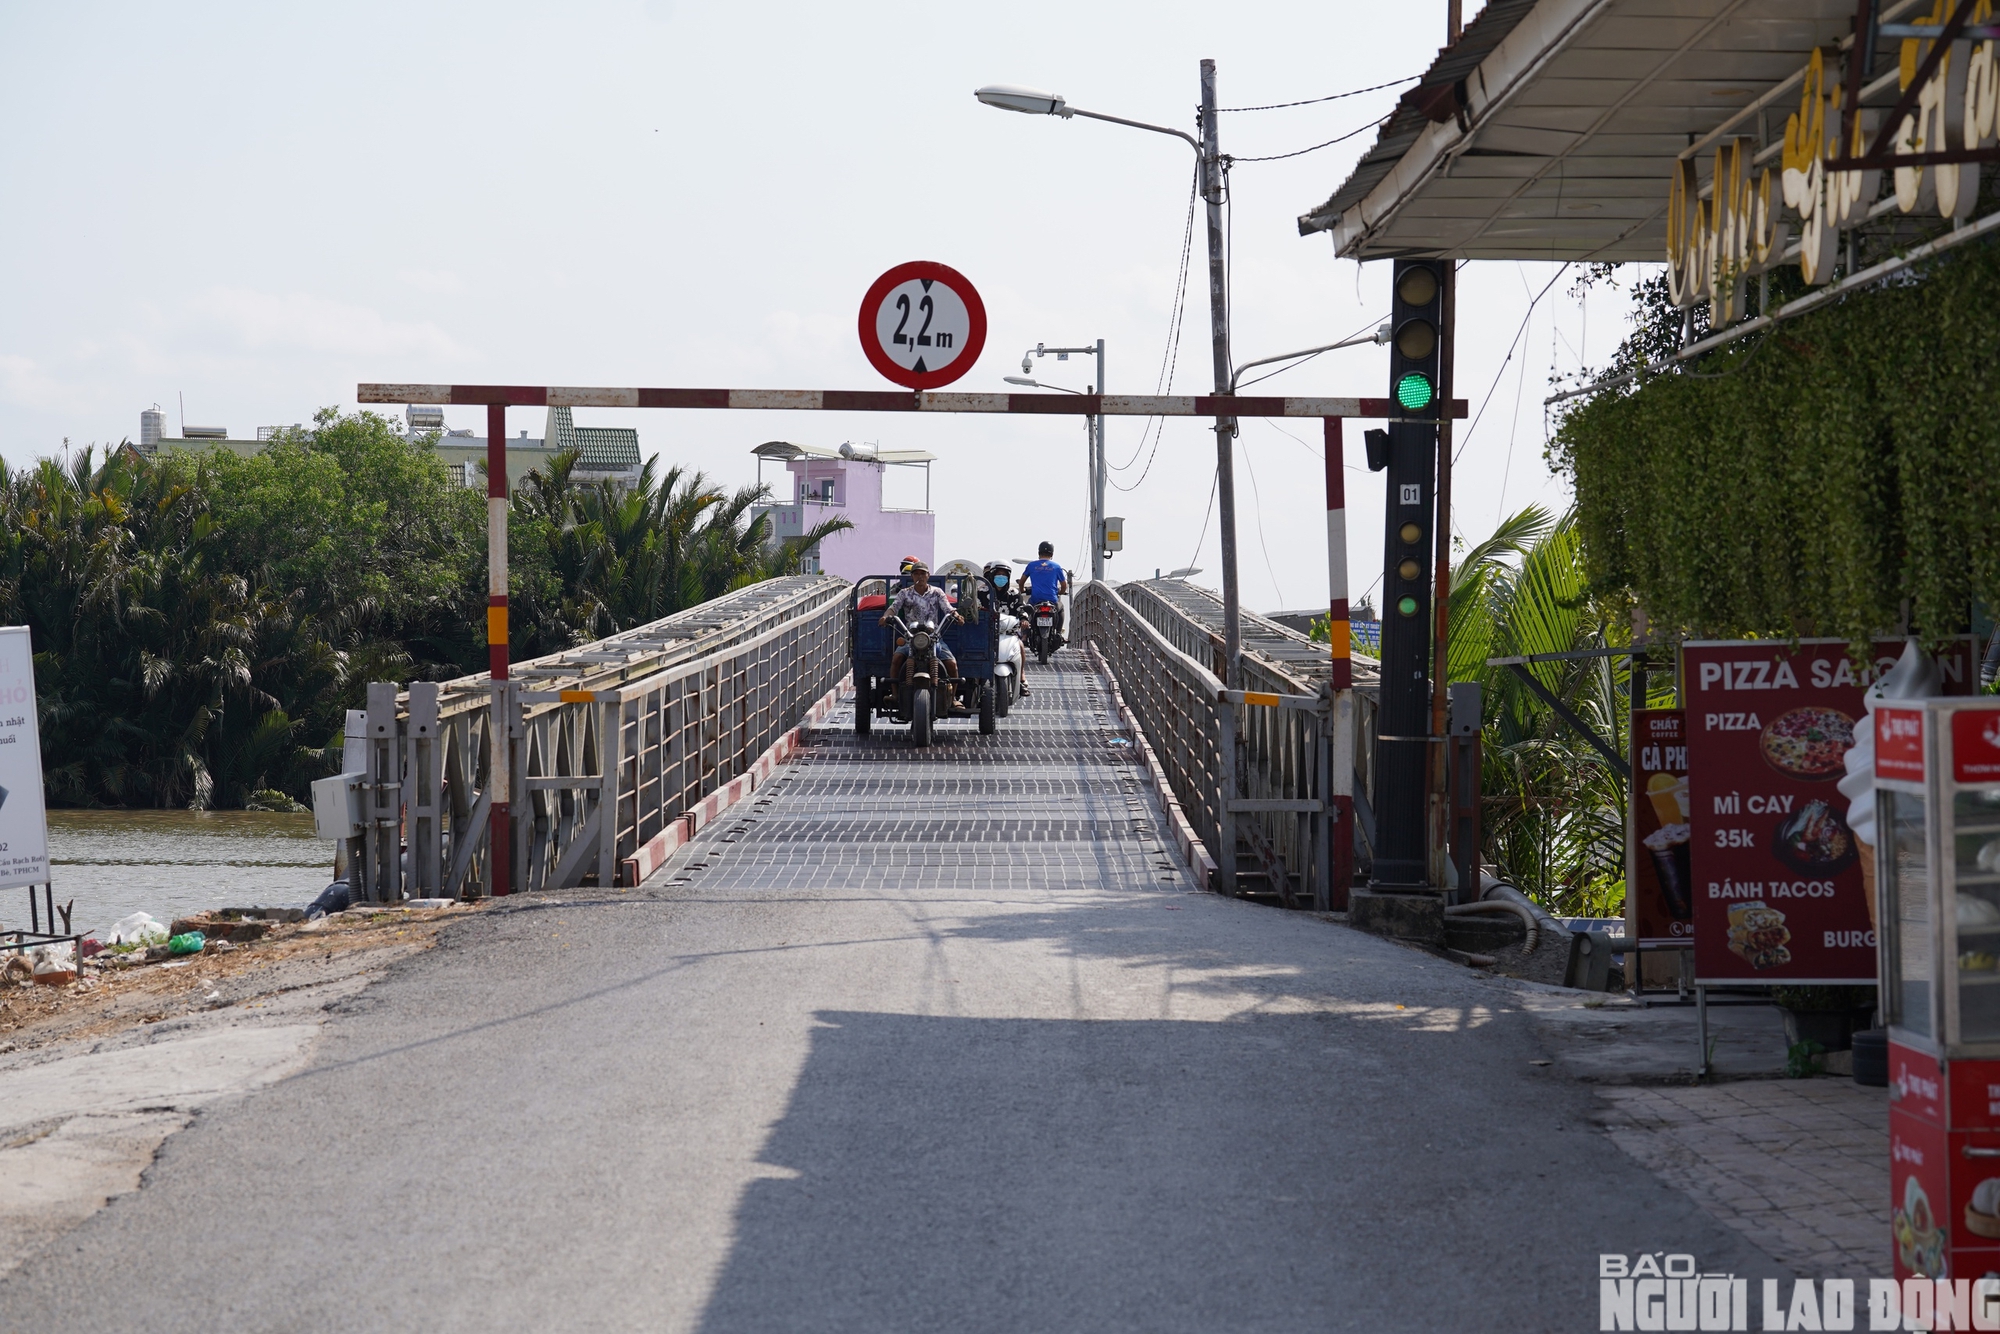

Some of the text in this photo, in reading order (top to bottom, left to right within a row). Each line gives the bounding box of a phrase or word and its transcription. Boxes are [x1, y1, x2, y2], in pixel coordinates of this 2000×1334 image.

[1667, 137, 1778, 329] Coffee
[893, 293, 953, 353] 2,2 m
[1403, 488, 1418, 501] 01
[1700, 660, 1799, 691] PIZZA
[6, 716, 25, 727] nhật
[1705, 712, 1762, 731] PIZZA
[1641, 742, 1688, 770] CÀ PH
[1713, 790, 1794, 814] MÌ CAY
[1715, 829, 1755, 848] 35k
[13, 866, 39, 875] TPHCM
[1708, 877, 1835, 898] BÁNH TACOS
